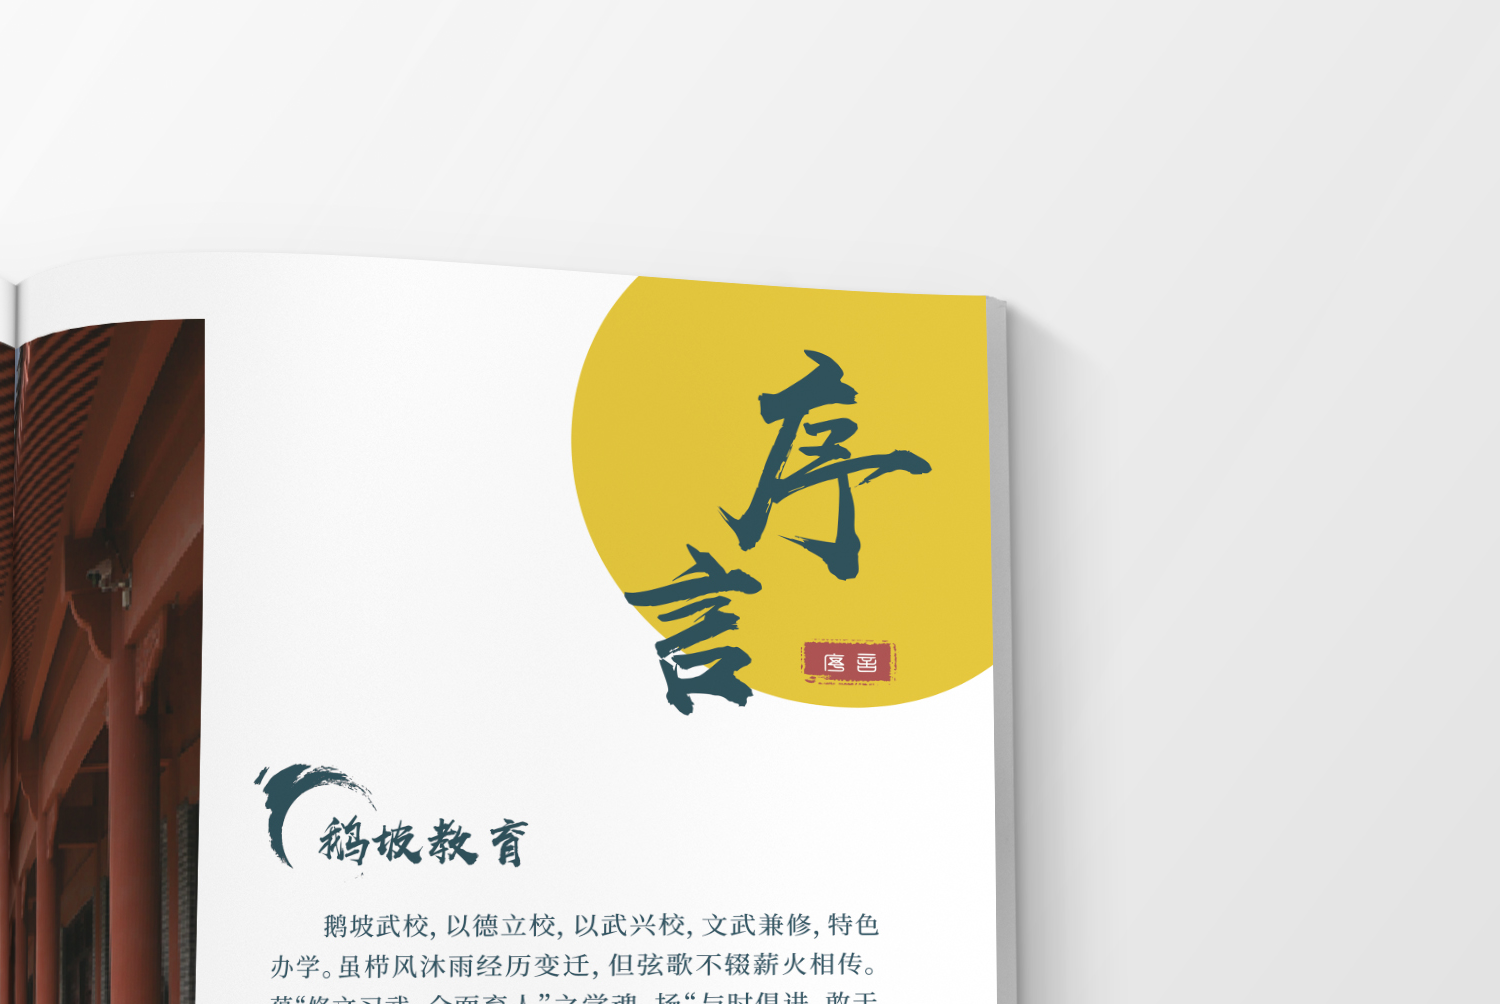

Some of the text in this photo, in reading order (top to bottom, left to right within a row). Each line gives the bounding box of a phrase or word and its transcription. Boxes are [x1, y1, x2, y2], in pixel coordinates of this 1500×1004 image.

[624, 350, 933, 716] 序言
[318, 814, 529, 868] 鹅坡教育
